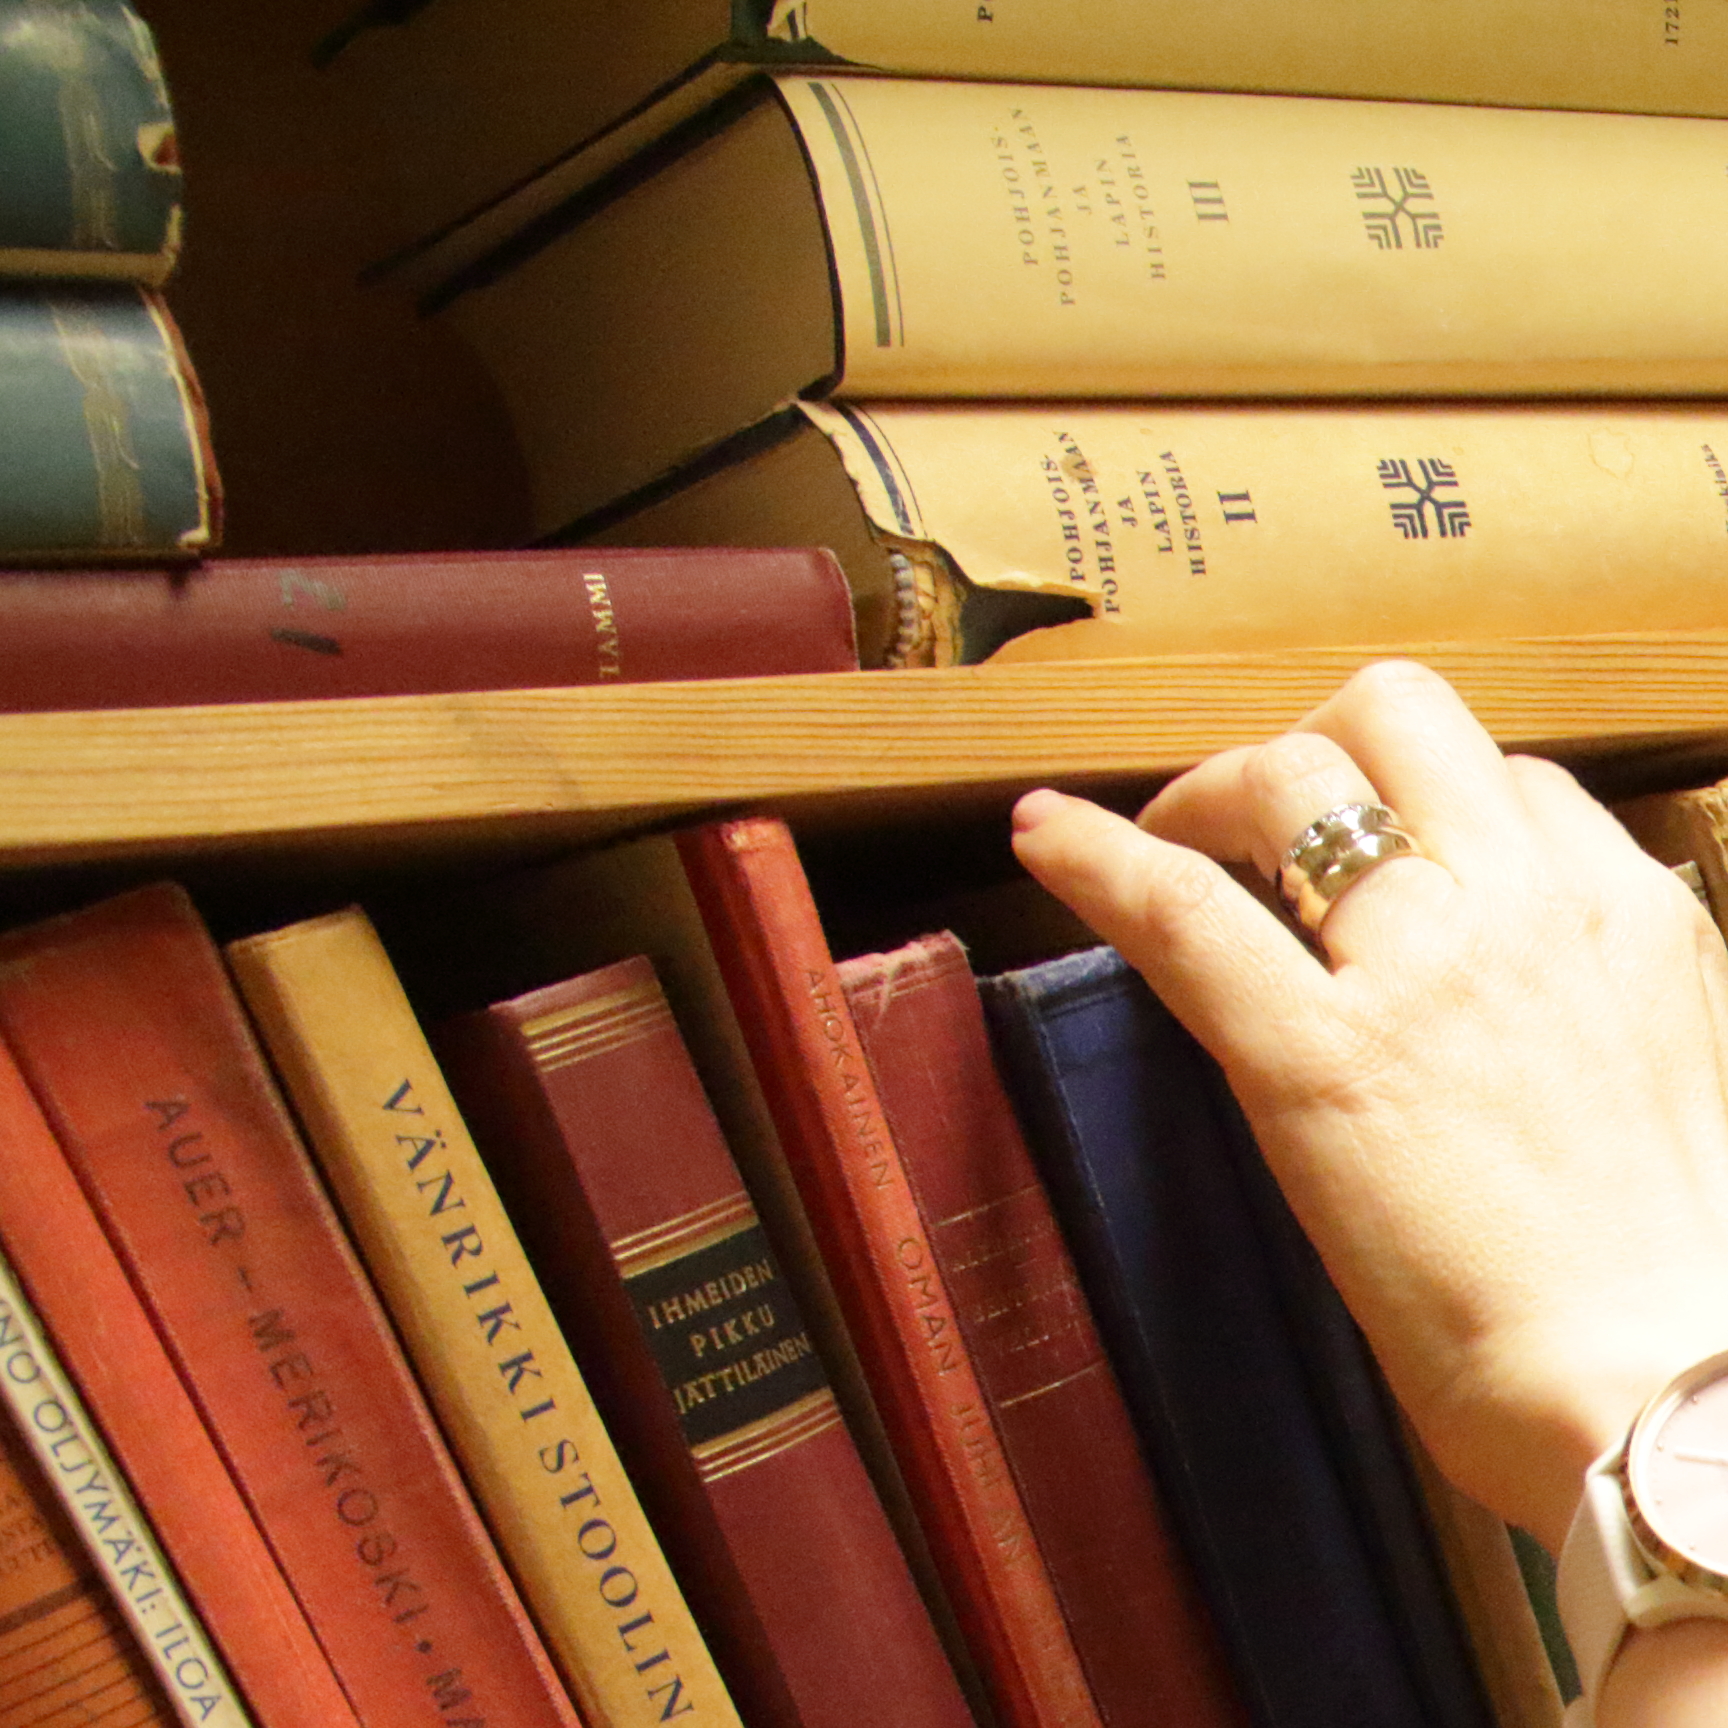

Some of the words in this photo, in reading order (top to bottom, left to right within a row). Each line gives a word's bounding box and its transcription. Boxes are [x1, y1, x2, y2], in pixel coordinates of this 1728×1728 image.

[1072, 185, 1092, 215] JA
[1096, 158, 1131, 247] LAPIN
[1116, 135, 1166, 280] HISTORIA
[1187, 179, 1230, 224] III
[1053, 429, 1120, 614] POHJANMAAN
[1116, 496, 1138, 528] JA
[1136, 469, 1174, 554] LAPIN
[1159, 451, 1207, 576] HISTORIA
[1216, 490, 1258, 525] II
[582, 572, 622, 677] TAMMI
[648, 1257, 775, 1330] IHMEIDEN
[688, 1303, 776, 1358] PIKKU
[898, 1236, 957, 1377] OMAN
[145, 1095, 249, 1247] AUER
[247, 1307, 430, 1625] MERIKOSKI
[382, 1078, 559, 1424] VÄNRIKKI
[538, 1437, 695, 1724] STOOLIN
[155, 1622, 224, 1721] ILOA
